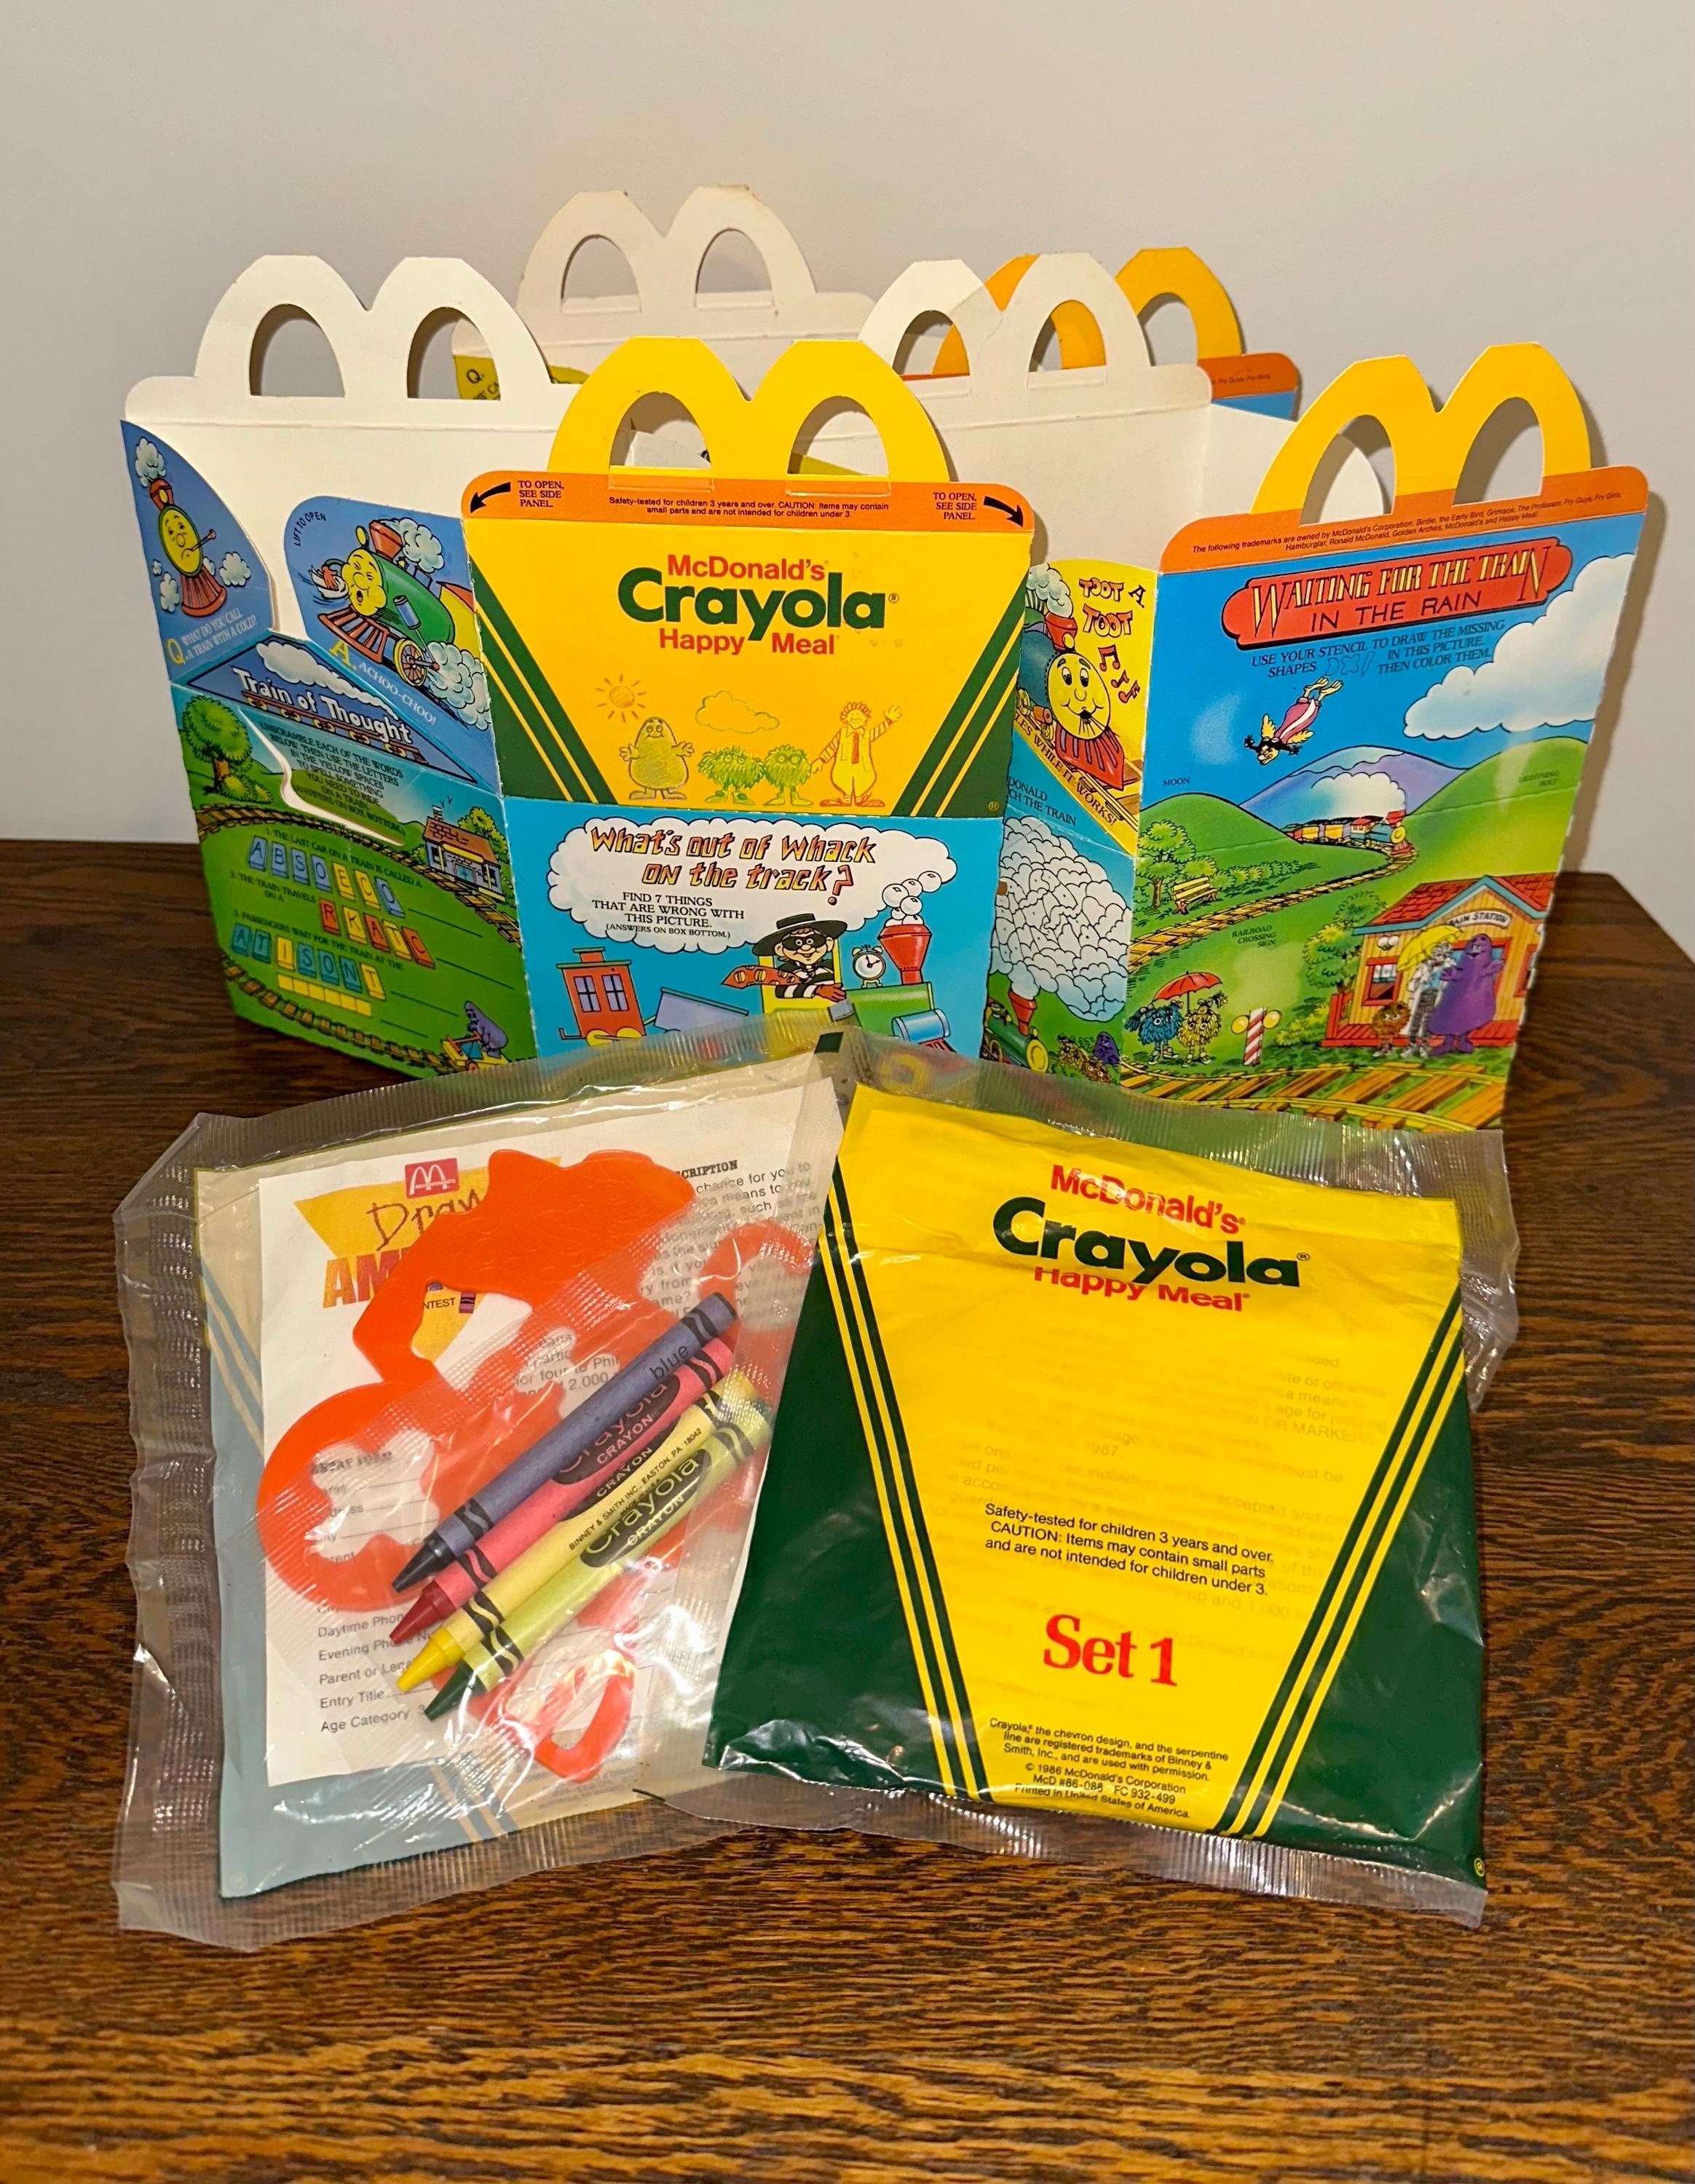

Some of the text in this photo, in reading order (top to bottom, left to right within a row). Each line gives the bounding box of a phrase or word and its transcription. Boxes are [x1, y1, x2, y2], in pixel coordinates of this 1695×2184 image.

[518, 480, 564, 490] TO OPEN,
[933, 492, 976, 502] TO OPEN,
[520, 499, 553, 507] PANEL.
[299, 516, 306, 530] TO
[306, 511, 326, 521] OPEN
[668, 554, 825, 581] McDonald's
[1379, 565, 1422, 594] FOR
[1429, 557, 1474, 588] THE
[1478, 546, 1551, 601] TRAIN
[1079, 577, 1123, 601] TOOT
[1082, 604, 1133, 638] TOOT
[1311, 590, 1481, 631] IN THE RAIN
[660, 628, 834, 655] Happy Meal
[1252, 620, 1505, 666] USE YOUR STENCIL TO DRAW THE MISSING
[1268, 646, 1430, 678] SHAPES IN THIS
[1378, 662, 1410, 674] THEN
[1412, 656, 1450, 668] COLOR
[233, 666, 412, 744] Train of Thought
[358, 662, 436, 724] ACHOO-CHOO!
[1034, 735, 1117, 826] WHILE IT WORKS!
[1163, 778, 1190, 786] MOON
[1024, 796, 1076, 826] THE TRAIN
[590, 826, 682, 855] What's
[687, 833, 735, 858] out
[739, 834, 773, 860] of
[690, 862, 738, 887] the
[746, 863, 853, 905] track?
[592, 900, 744, 919] THAT ARE WRONG WITH
[623, 892, 652, 902] FIND
[665, 895, 712, 906] THINGS
[606, 923, 652, 932] (ANSWERS
[690, 930, 730, 938] BOTTOM.)
[625, 913, 712, 927] THIS PICTURE.
[1232, 925, 1272, 938] RAILROAD
[1473, 913, 1507, 922] STATION
[1238, 933, 1276, 945] CROSSING
[1257, 939, 1275, 947] SIGN
[749, 1173, 765, 1183] for
[740, 1201, 772, 1214] such
[1035, 1267, 1243, 1311] Happy Meal
[649, 1345, 689, 1381] blue
[597, 1413, 653, 1465] CRAYON
[597, 1447, 652, 1497] CRAYON
[585, 1459, 699, 1554] Crayola
[628, 1495, 684, 1546] CRAYON
[569, 1500, 625, 1550] BINNEY SMITH
[985, 1503, 1273, 1562] Safety-tested for children 3 years and over.
[991, 1521, 1265, 1578] CAUTION: Items may contain small parts
[985, 1537, 1268, 1596] and are not intended for children under 3.
[318, 1622, 368, 1637] Daytime
[319, 1642, 369, 1660] Evening
[1043, 1613, 1177, 1686] Set 1
[320, 1667, 376, 1685] Parent or
[320, 1690, 384, 1708] Entry Title
[321, 1709, 408, 1733] Age Category
[1004, 1731, 1211, 1770] line are registered trademarks of Binney &
[1035, 1726, 1051, 1736] the
[1054, 1729, 1093, 1742] chevron
[1135, 1742, 1154, 1752] and
[1157, 1744, 1172, 1754] the
[1176, 1747, 1228, 1761] serpentine
[1004, 1742, 1209, 1781] Smith, Inc., and are used with permission.
[1033, 1775, 1175, 1804] McD FC 932-499
[1038, 1764, 1186, 1794] 1986 McDonald's Corporation
[1101, 1795, 1190, 1819] States of America.
